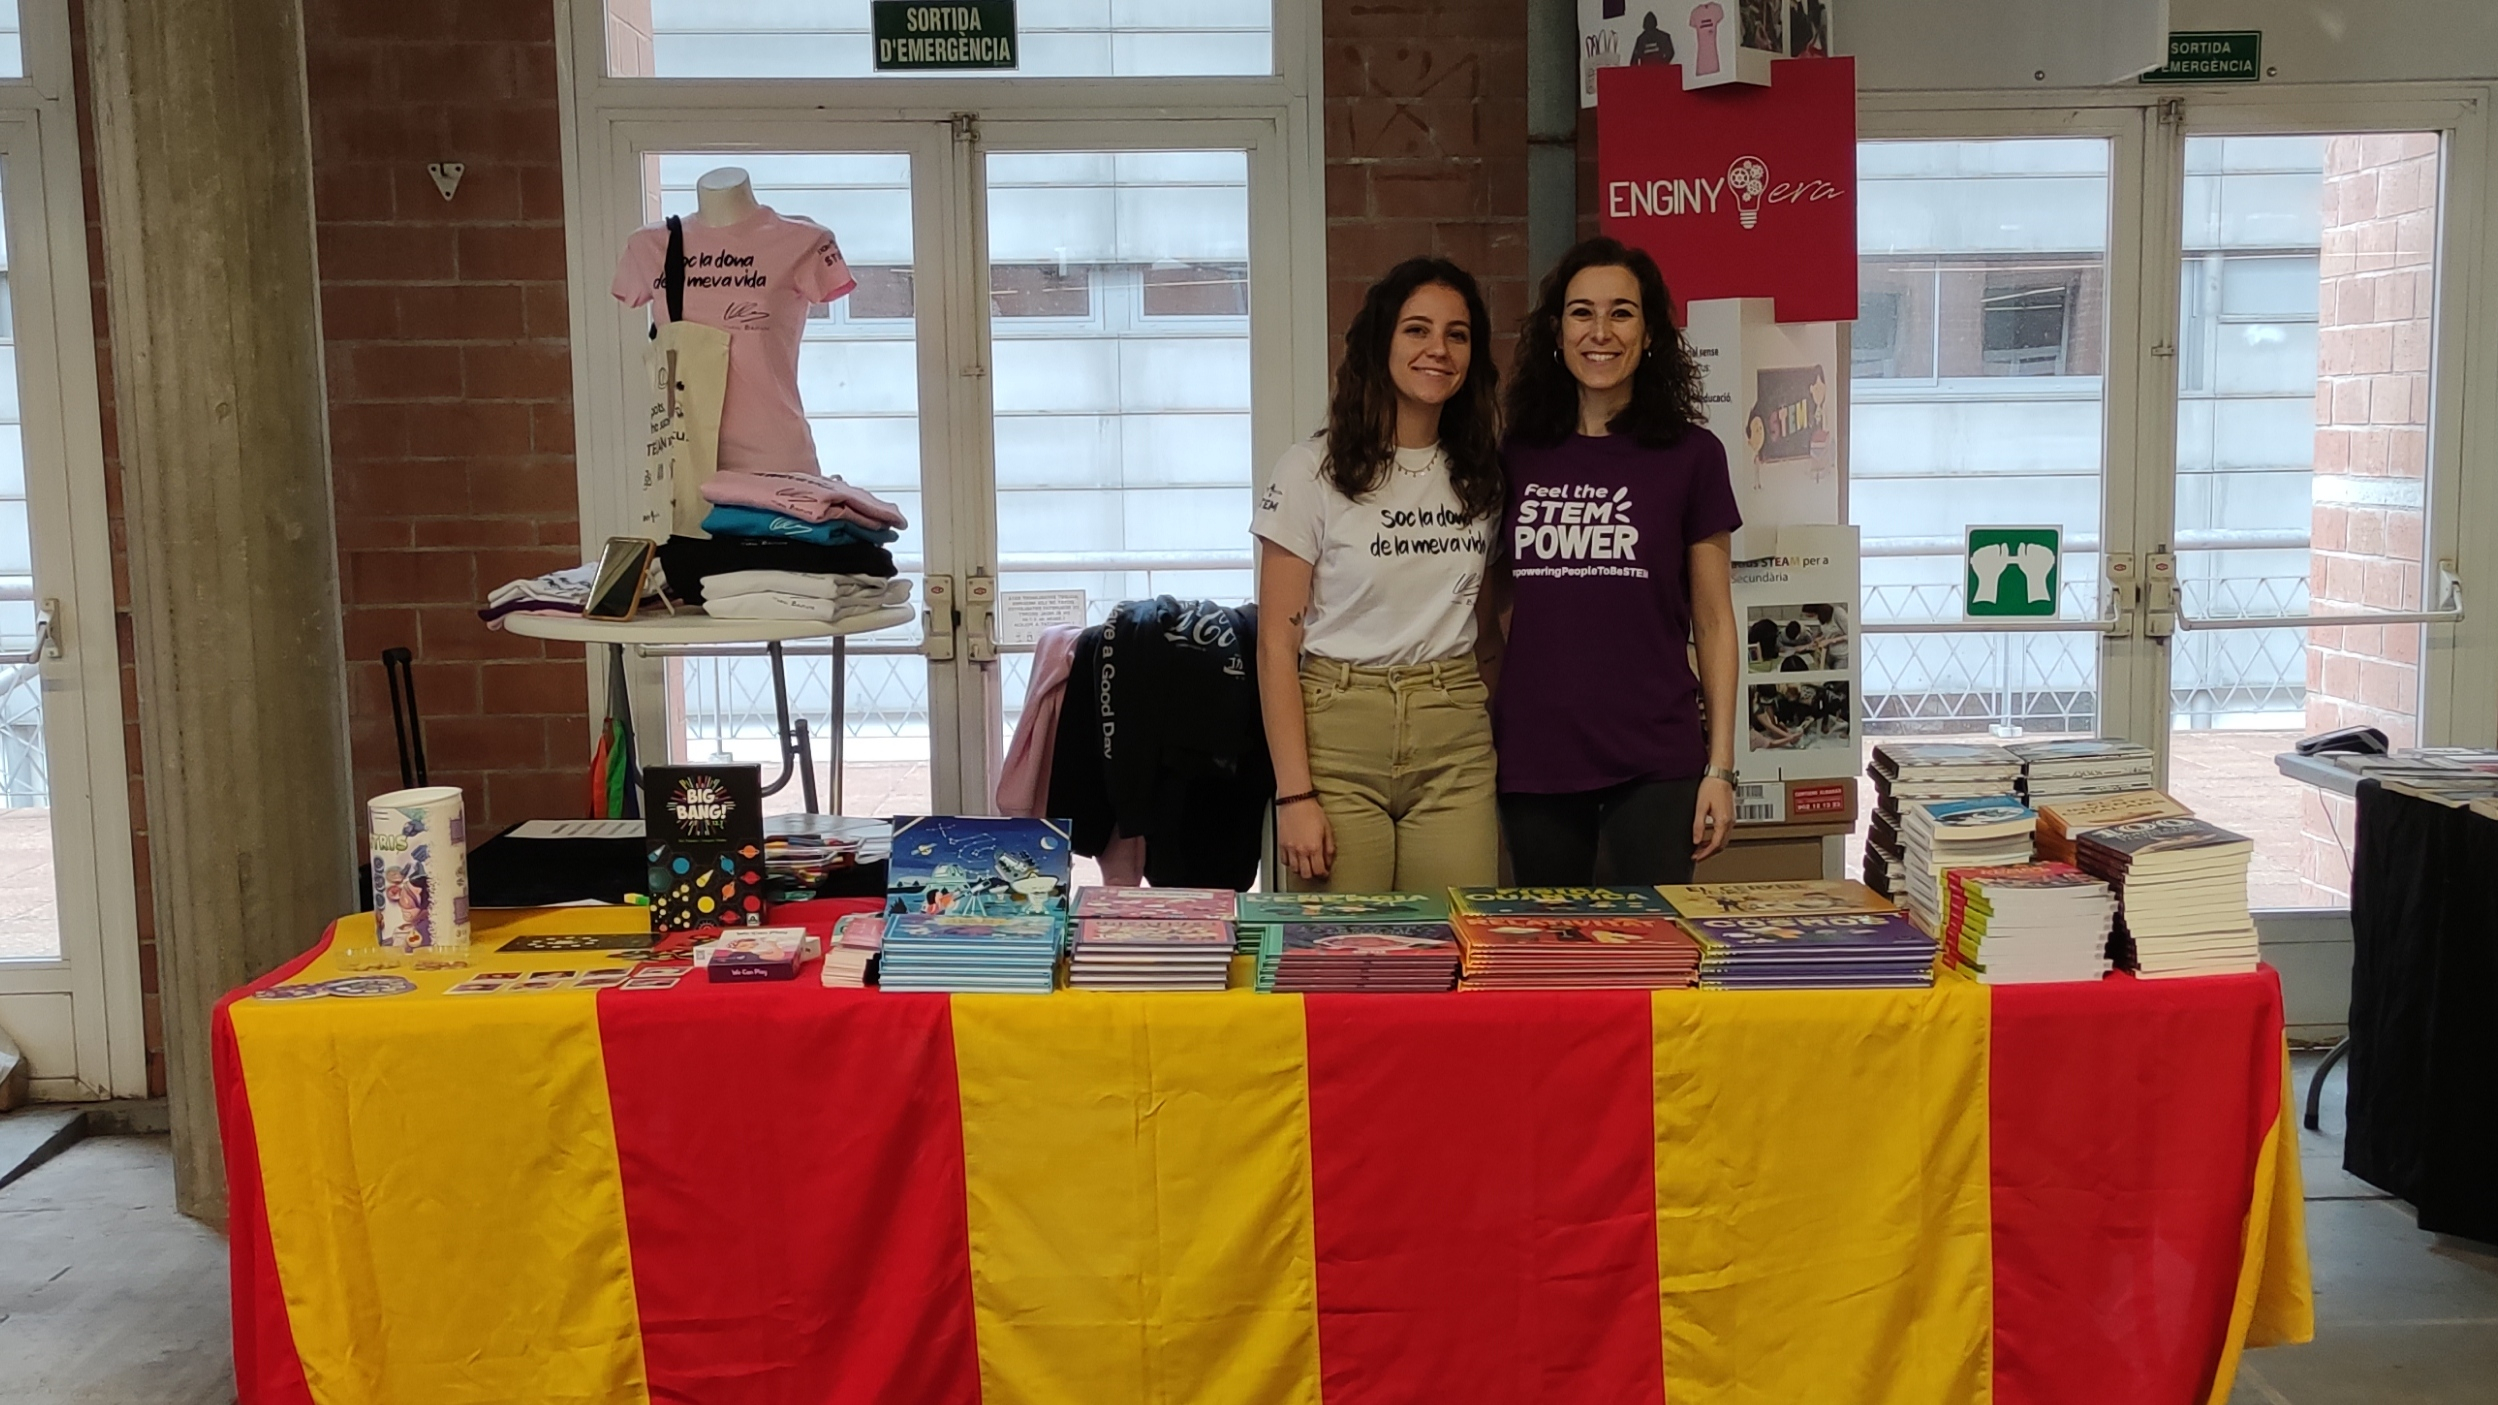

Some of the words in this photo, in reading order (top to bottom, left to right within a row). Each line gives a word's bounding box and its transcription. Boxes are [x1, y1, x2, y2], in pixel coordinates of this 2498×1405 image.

[907, 7, 982, 32] SORTIDA
[880, 32, 1011, 62] D'EMERGÈNCIA
[2170, 42, 2231, 55] SORTIDA
[1609, 177, 1725, 217] ENGINY
[1768, 180, 1845, 204] era
[682, 255, 697, 268] oc
[699, 252, 713, 268] la
[714, 249, 754, 269] dona
[687, 275, 732, 289] meva
[734, 268, 767, 289] vida
[1524, 483, 1568, 498] Feel
[1574, 484, 1608, 498] the
[1418, 506, 1434, 528] la
[1517, 500, 1613, 524] STEM
[1370, 532, 1392, 558] de
[1394, 534, 1409, 556] la
[1411, 536, 1461, 555] meva
[1515, 524, 1639, 561] POWER
[1761, 555, 1800, 568] STEAM
[1802, 557, 1820, 568] per
[1822, 557, 1829, 565] a
[1102, 645, 1114, 658] a
[1100, 663, 1116, 717] Good
[687, 788, 715, 804] BIG
[676, 804, 727, 820] BANG!
[1703, 915, 1889, 928] COSMOS
[742, 968, 754, 976] Can
[754, 968, 768, 977] Play
